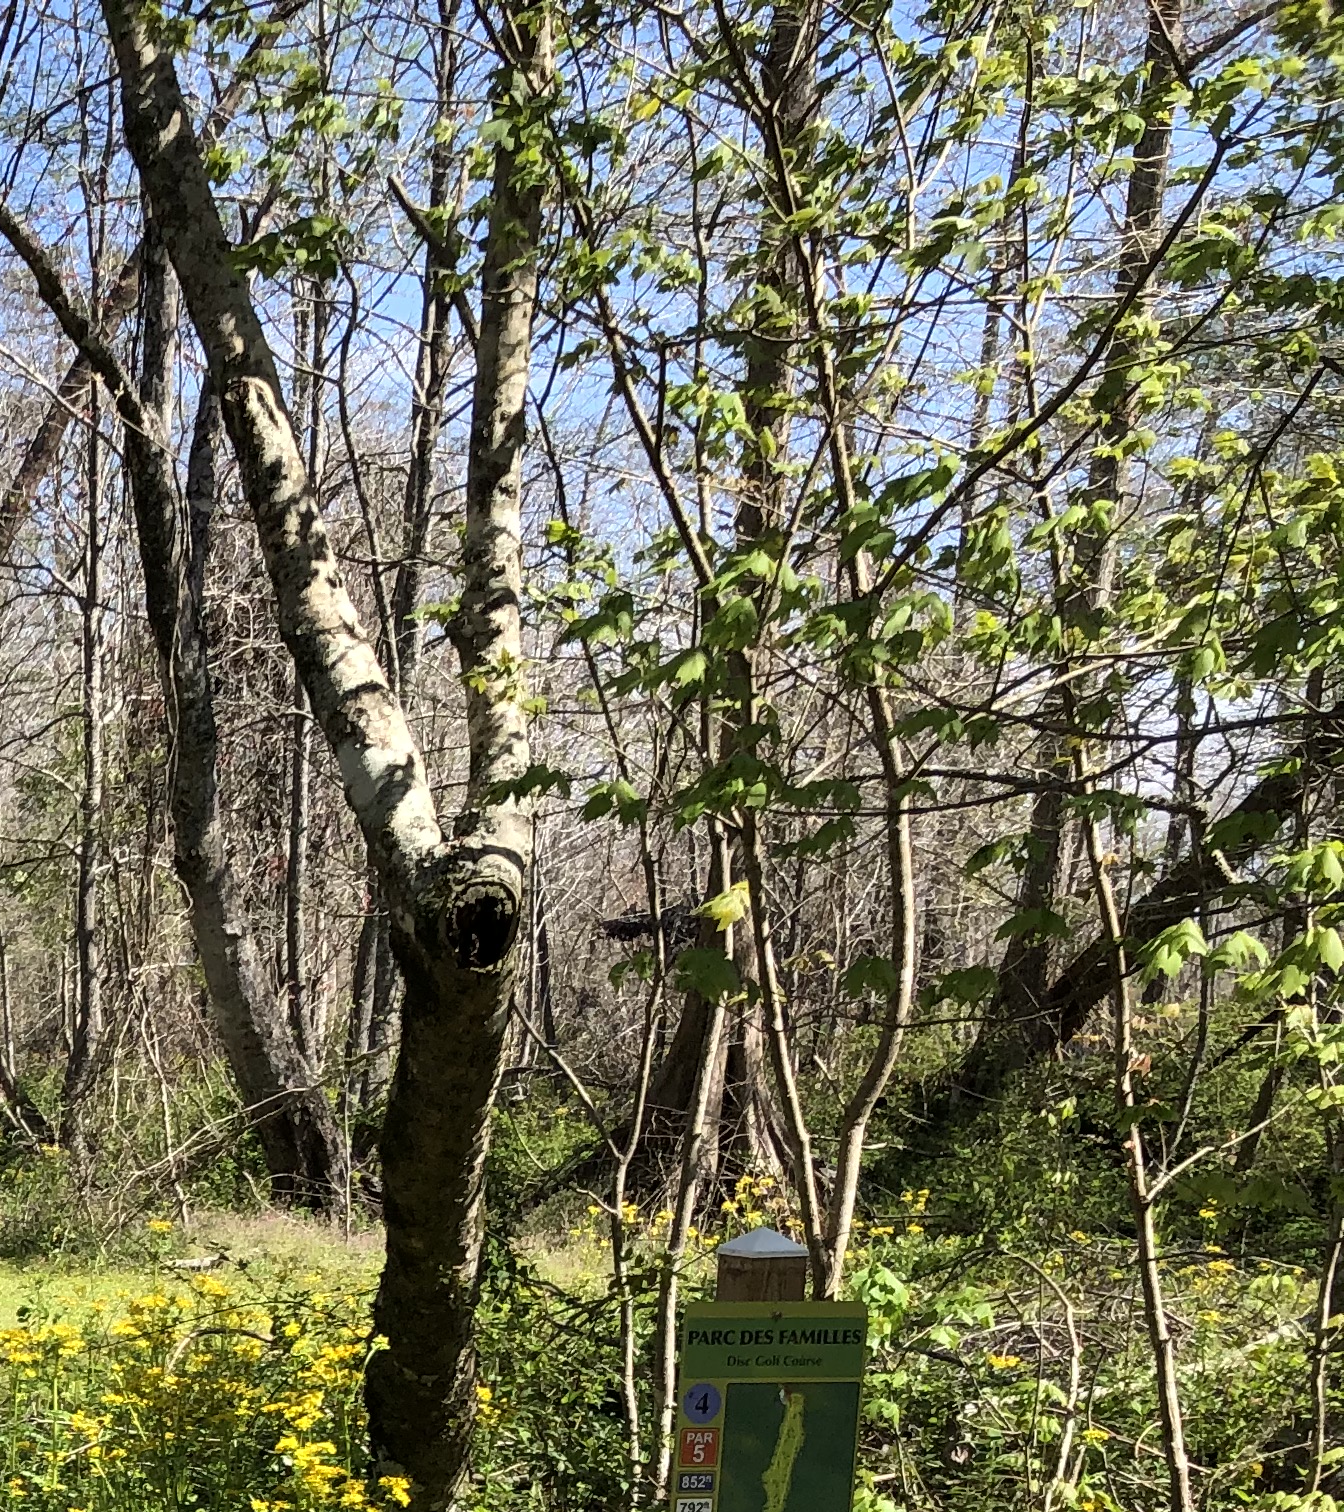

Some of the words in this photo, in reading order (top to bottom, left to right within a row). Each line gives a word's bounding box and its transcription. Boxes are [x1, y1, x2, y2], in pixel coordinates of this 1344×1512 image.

[687, 1330, 736, 1346] PARC
[739, 1330, 774, 1345] DES
[778, 1329, 862, 1345] FAMILLES
[727, 1355, 752, 1367] Disc
[755, 1355, 781, 1367] Golf
[783, 1355, 823, 1367] Course
[686, 1432, 713, 1444] PAR
[692, 1444, 706, 1463] 5
